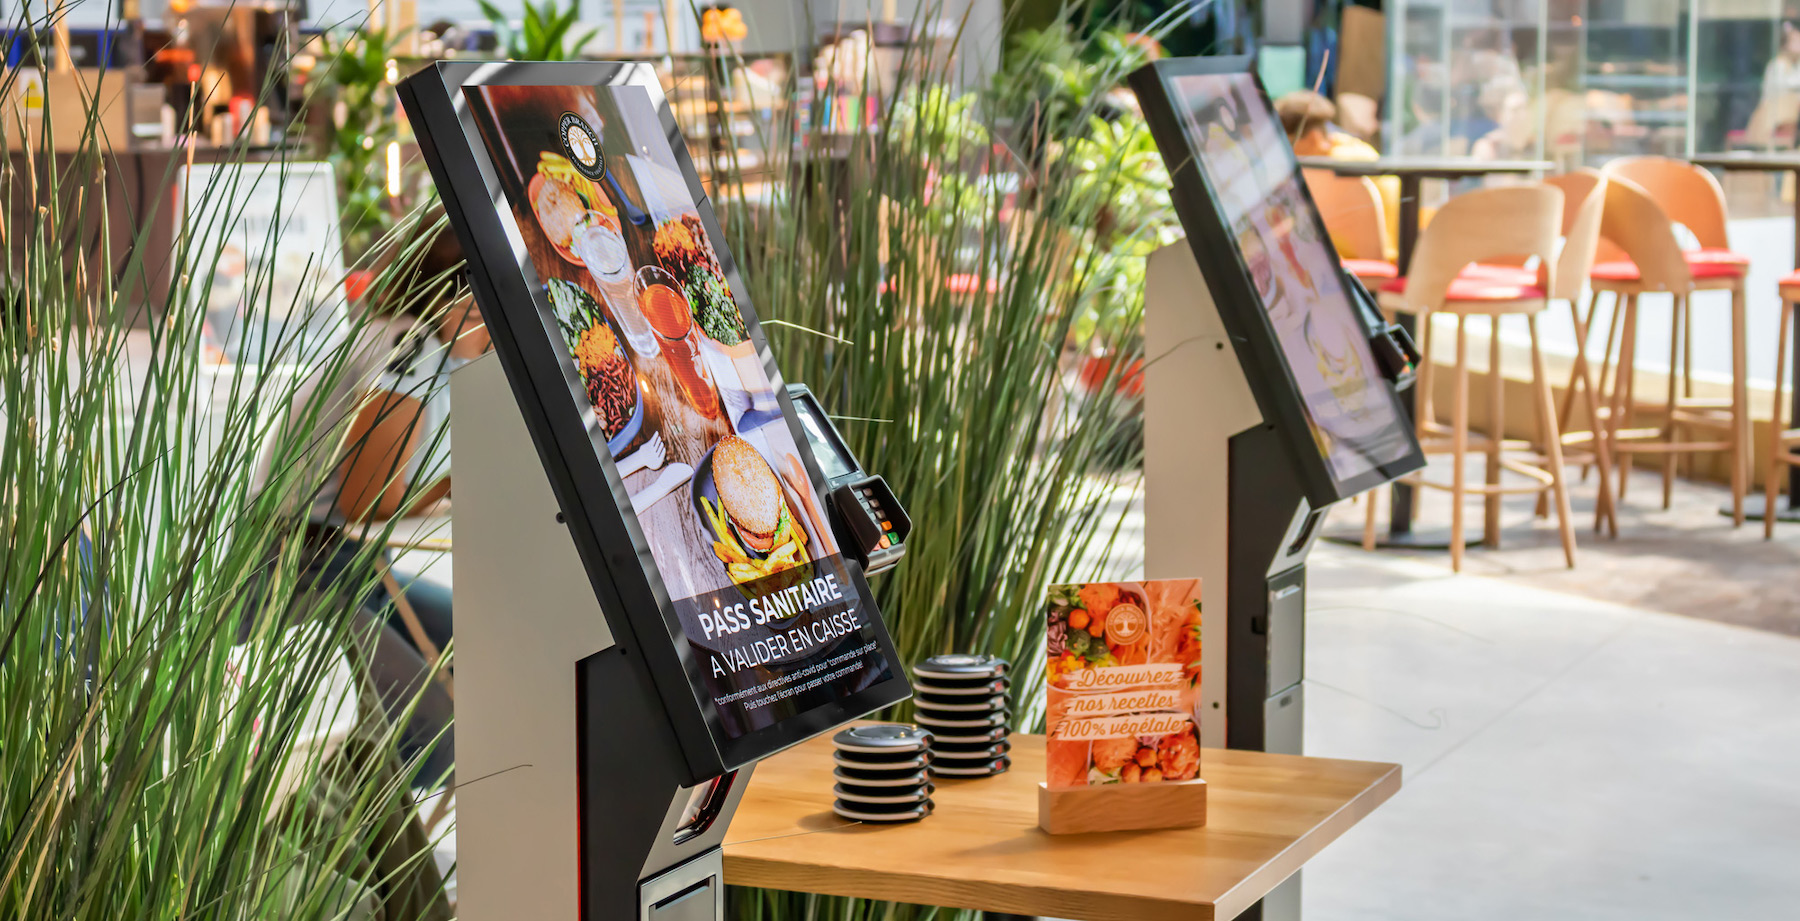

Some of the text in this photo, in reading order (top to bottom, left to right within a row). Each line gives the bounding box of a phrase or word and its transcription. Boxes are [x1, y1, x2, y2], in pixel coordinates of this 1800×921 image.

[561, 116, 599, 147] COPPER BRANCH
[698, 573, 843, 640] PASS SANITAIRE
[710, 608, 861, 679] A VALIDER EN CAISSE
[744, 661, 863, 711] Puis touchez l'écran pour passer votre commande!
[757, 683, 768, 693] aux
[767, 675, 791, 689] directives
[791, 663, 816, 681] anti-covid
[816, 660, 828, 673] pour
[856, 648, 864, 657] sur
[1077, 667, 1174, 688] Découvrez
[1074, 692, 1174, 712] nos recettes
[1062, 717, 1186, 738] 100% végétales
